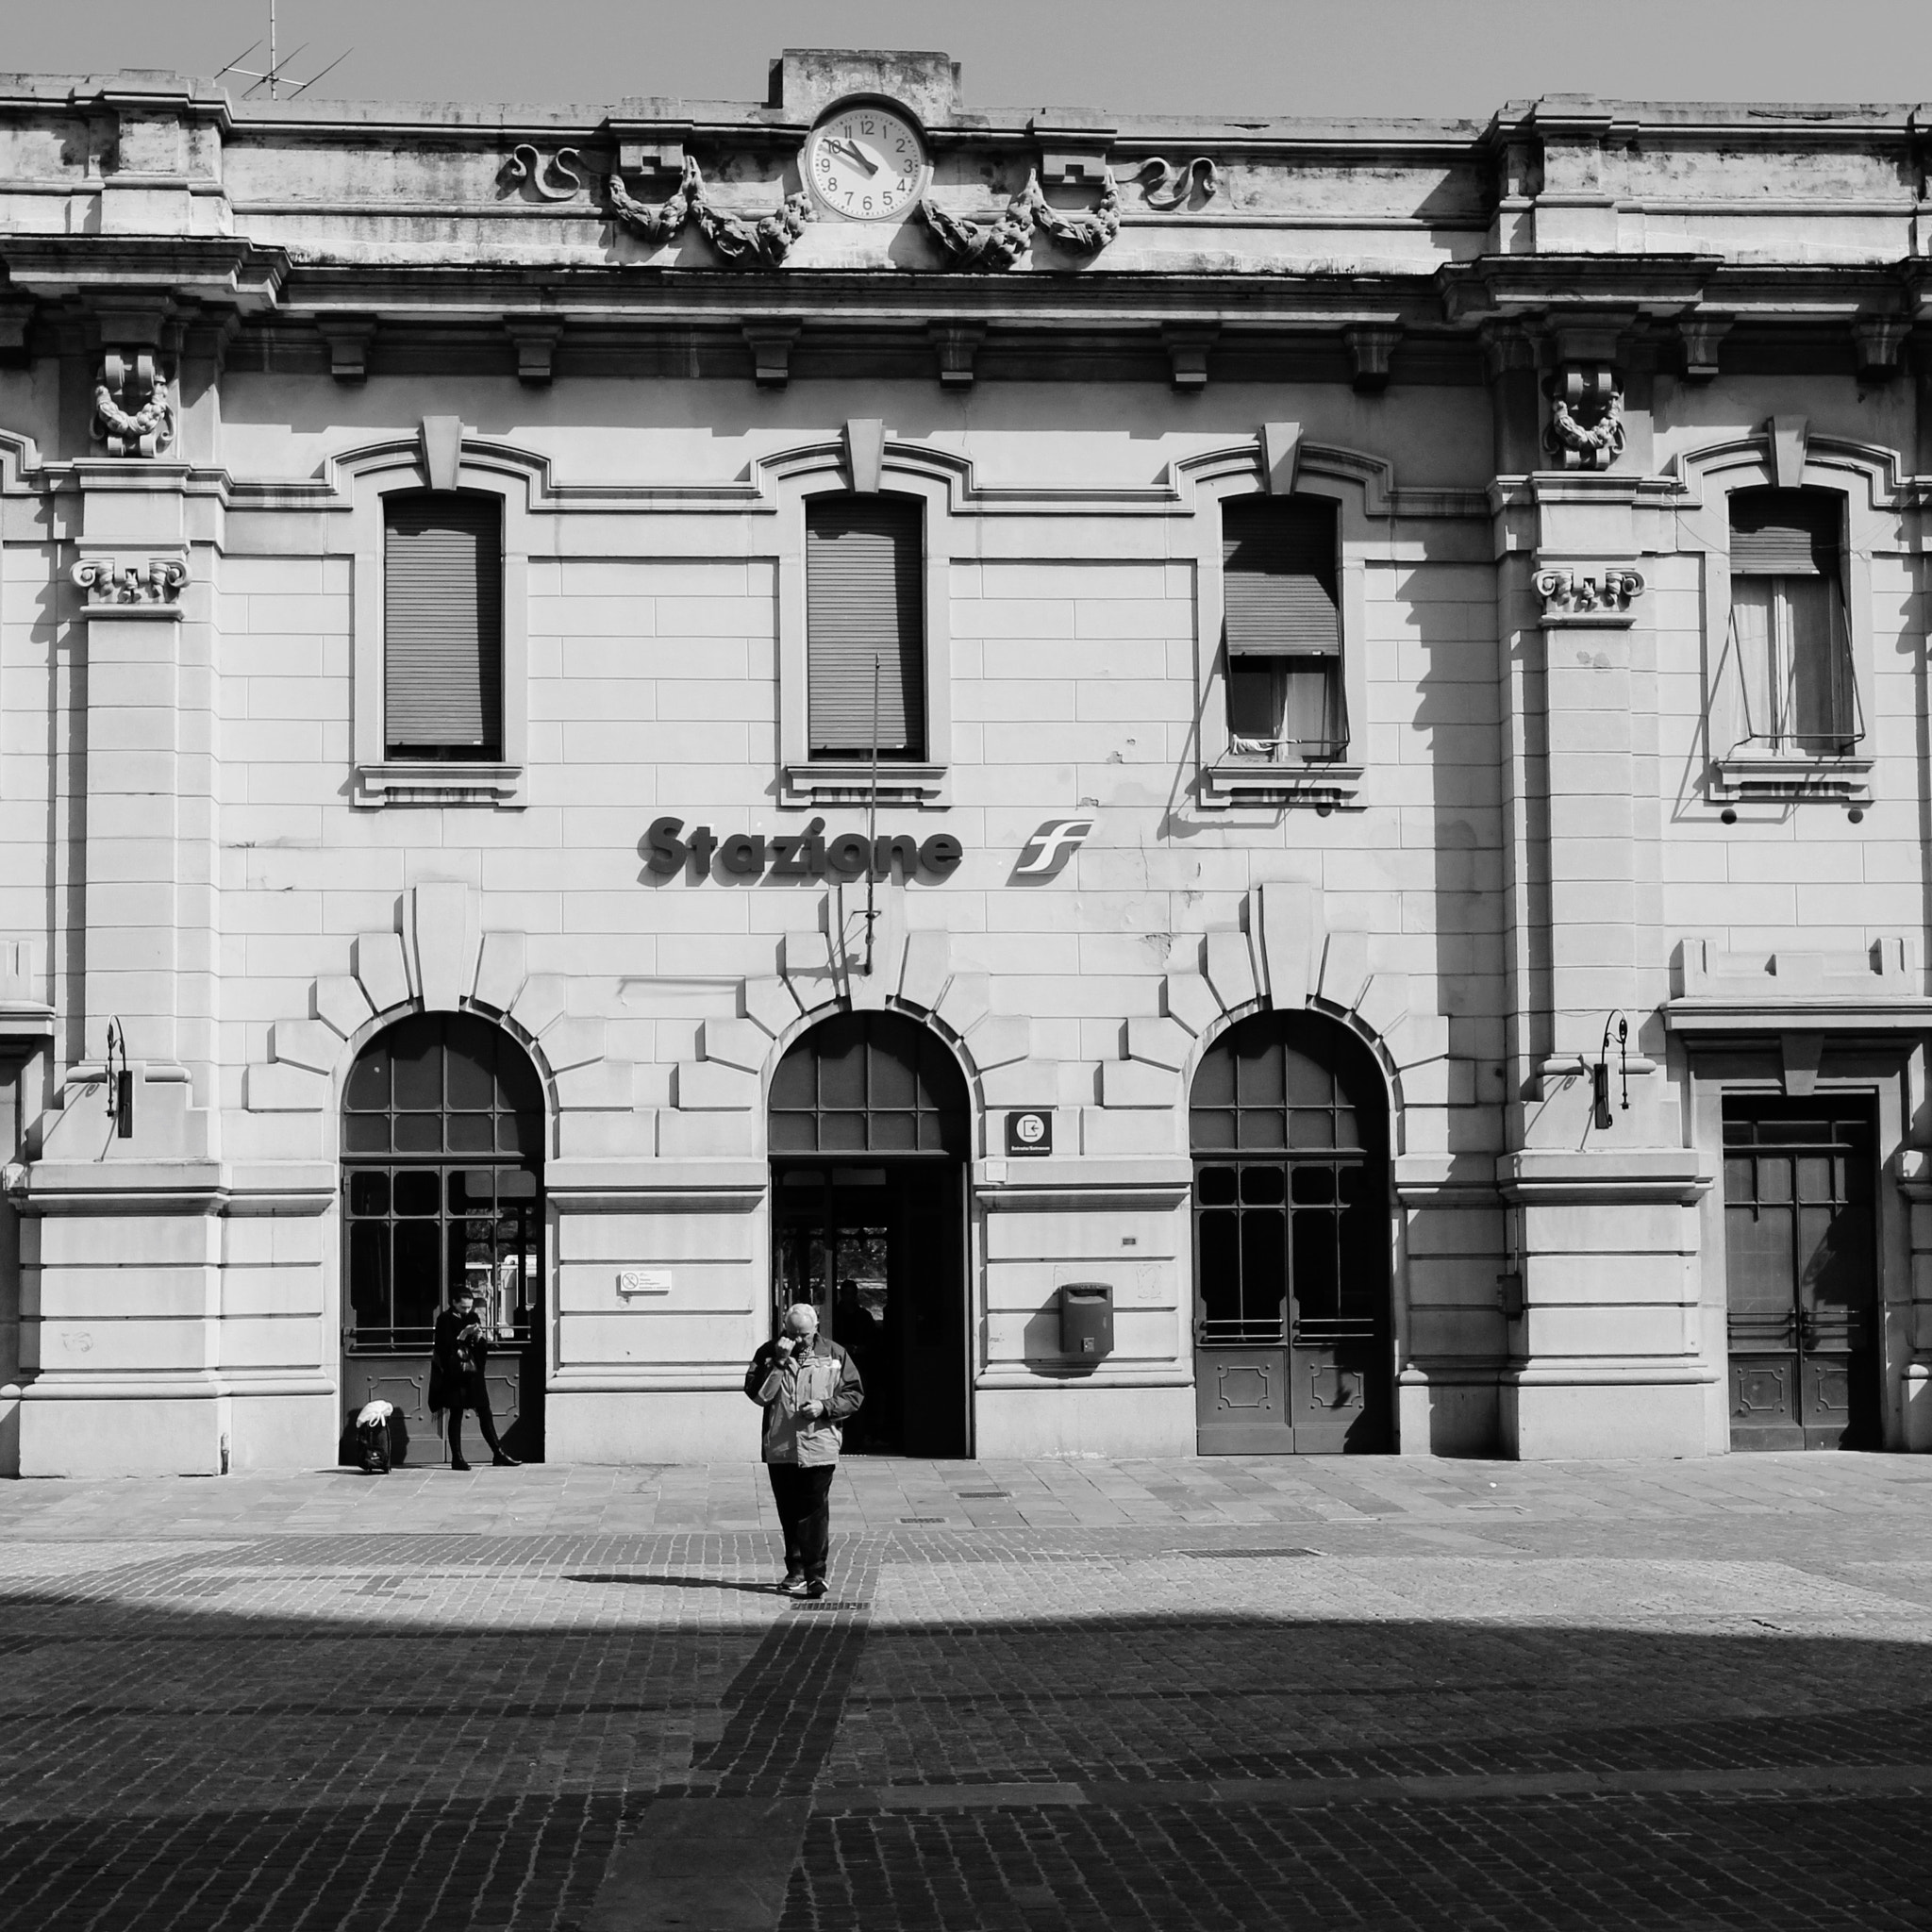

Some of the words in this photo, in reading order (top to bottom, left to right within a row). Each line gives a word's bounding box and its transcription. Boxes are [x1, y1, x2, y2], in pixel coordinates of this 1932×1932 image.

[844, 125, 852, 139] 11
[860, 121, 874, 135] 12
[883, 125, 887, 139] 1
[828, 140, 841, 154] 10
[896, 139, 906, 153] 2
[821, 158, 830, 173] 9
[903, 159, 913, 174] 3
[827, 177, 838, 192] 8
[896, 178, 906, 192] 4
[844, 192, 854, 206] 7
[863, 196, 872, 210] 6
[882, 192, 892, 206] 5
[648, 816, 963, 874] Stazione
